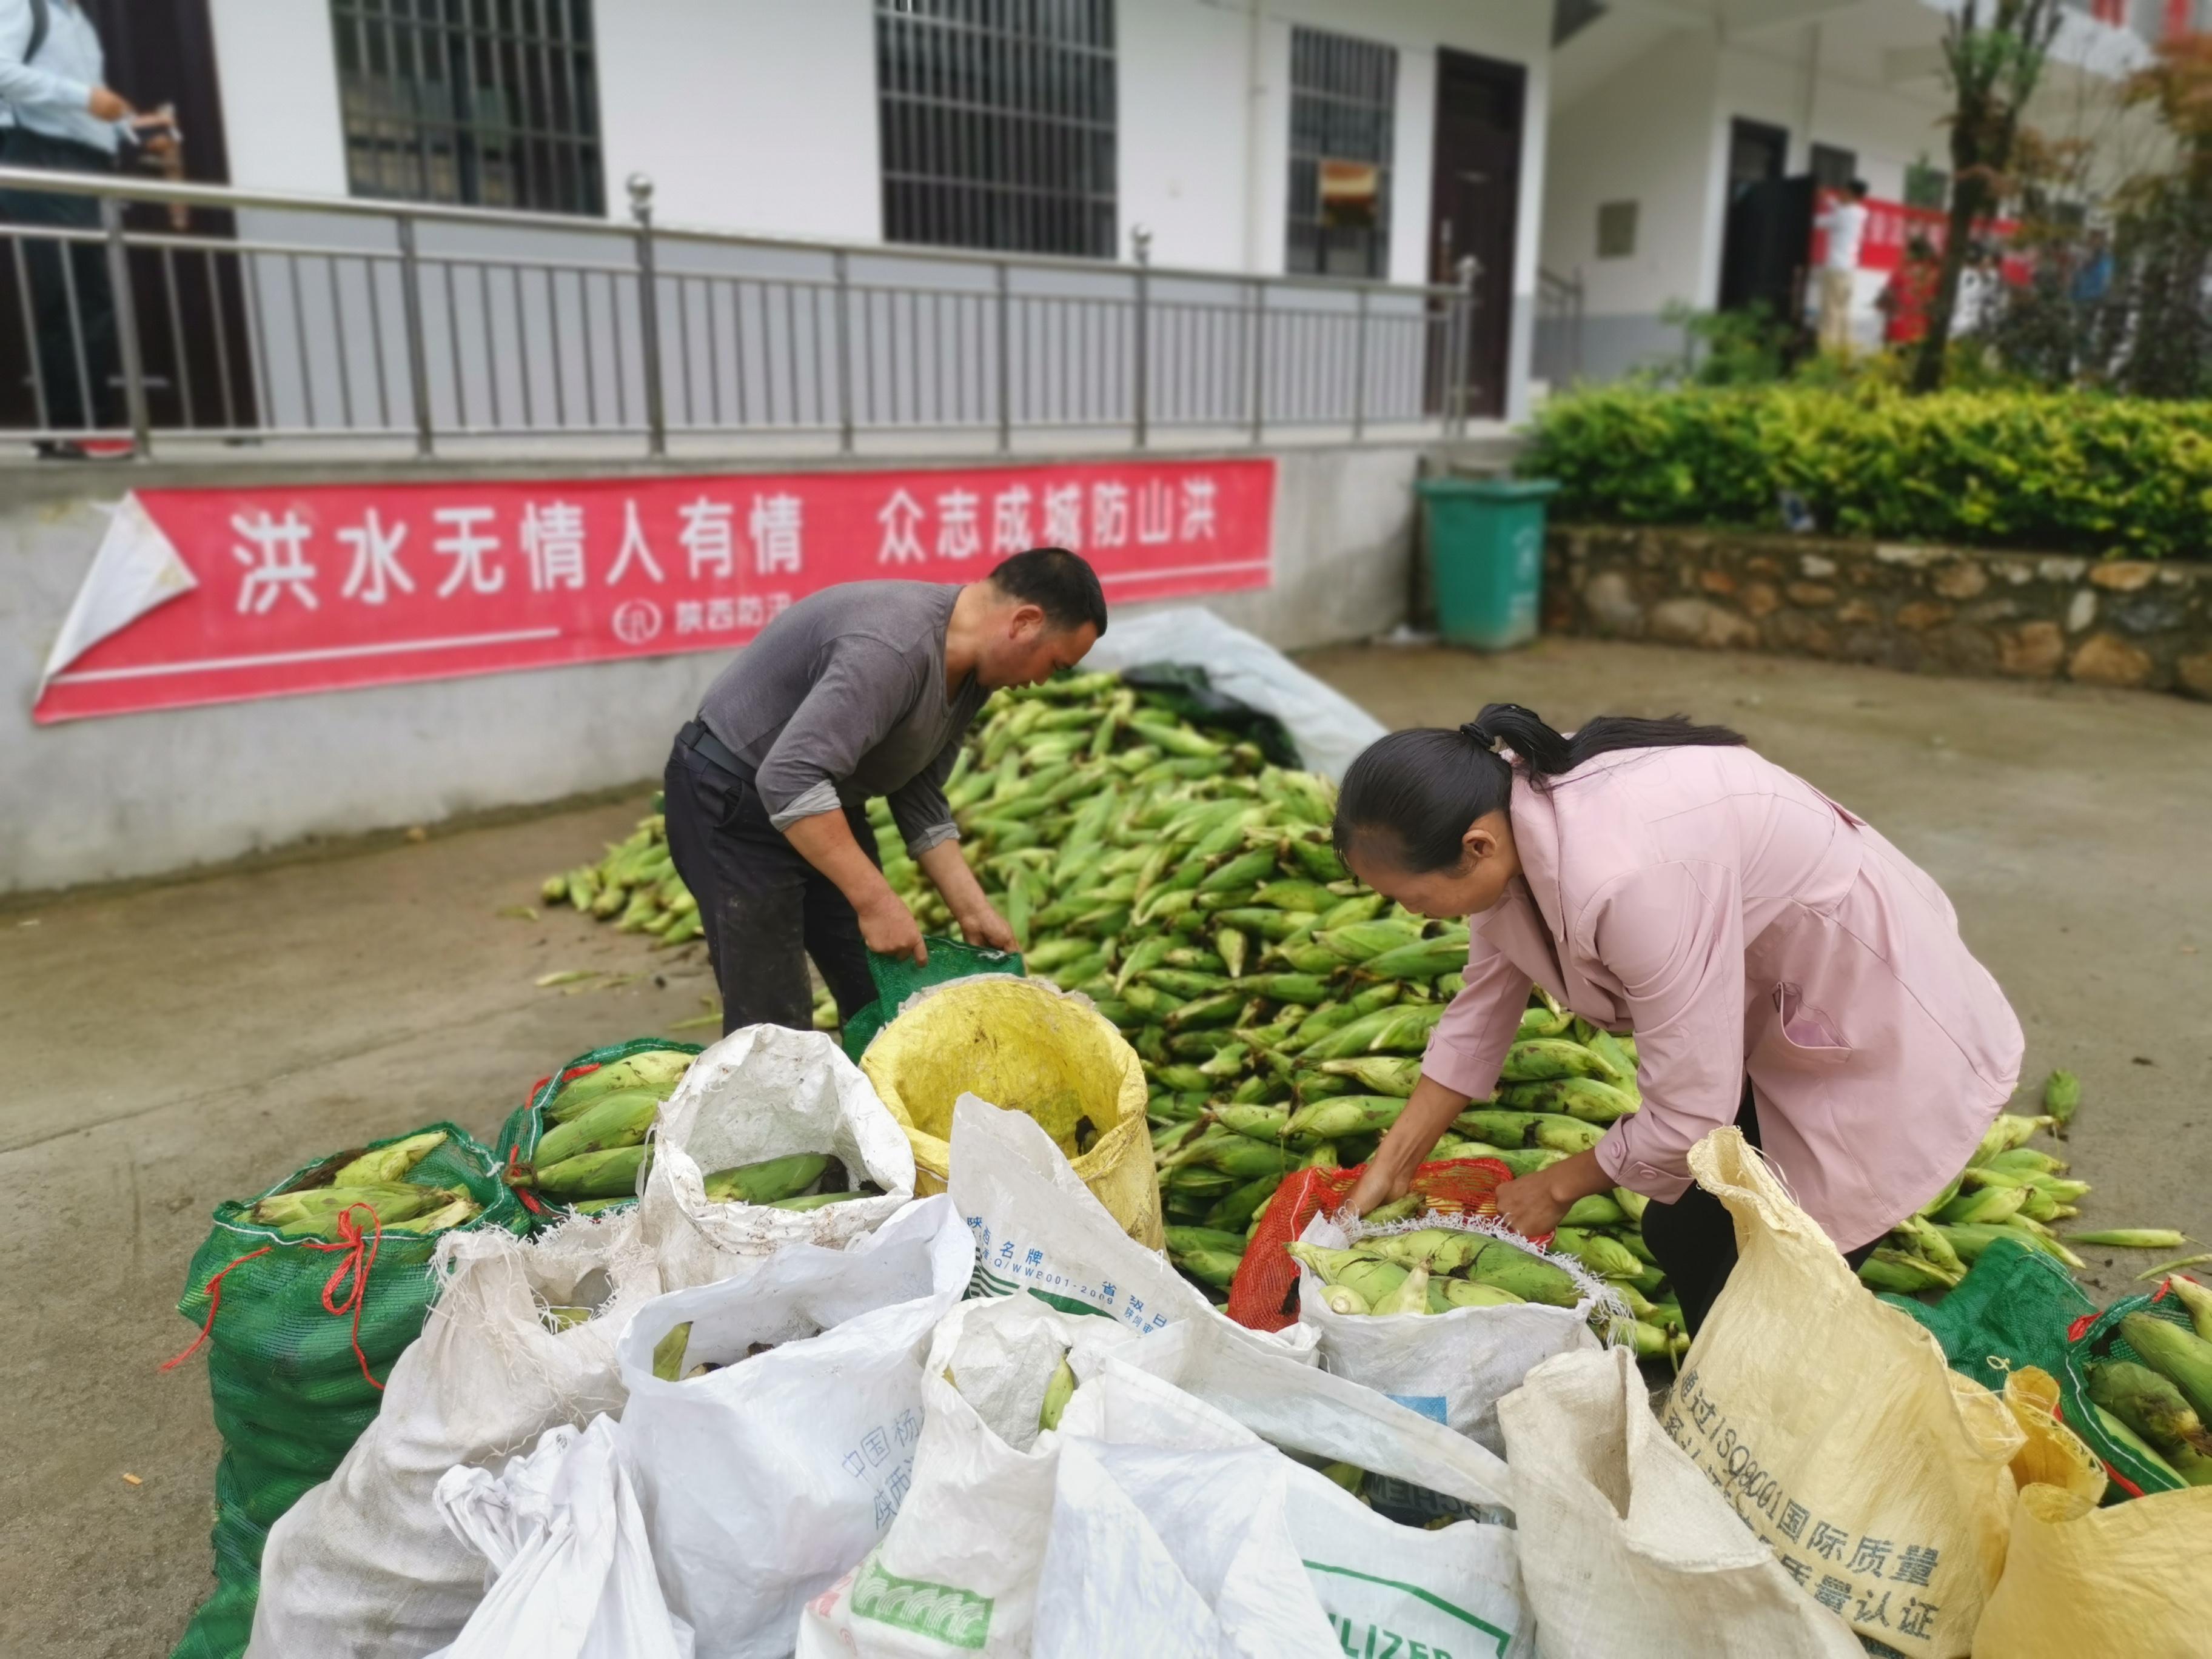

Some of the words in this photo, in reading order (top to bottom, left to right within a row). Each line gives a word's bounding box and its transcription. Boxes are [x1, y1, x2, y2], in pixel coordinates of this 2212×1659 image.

[231, 494, 802, 614] 洪水无情人有情
[877, 477, 1217, 564] 众志成城防山洪
[842, 1406, 925, 1482] 中国杨
[874, 1456, 914, 1531] 陕西
